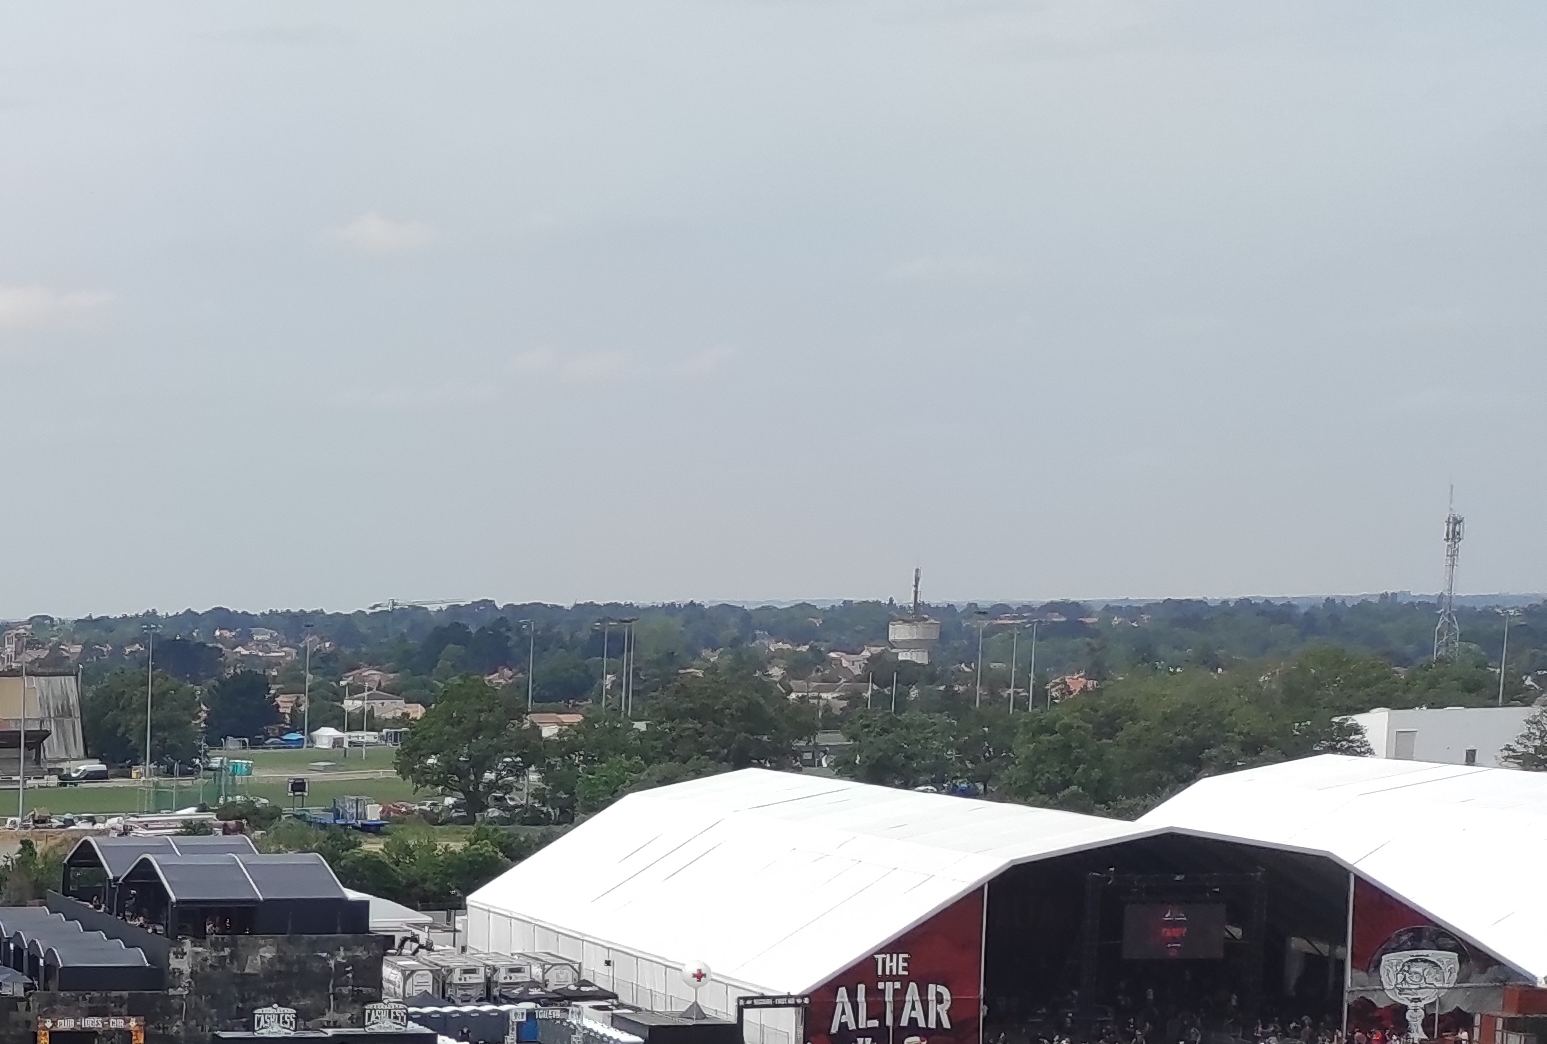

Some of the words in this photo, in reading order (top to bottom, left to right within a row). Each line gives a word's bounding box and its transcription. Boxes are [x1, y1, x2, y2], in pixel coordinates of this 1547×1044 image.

[873, 953, 911, 976] THE
[829, 981, 952, 1034] ALTAR
[254, 1013, 297, 1030] CASHLESS
[364, 1010, 407, 1027] CASHLESS
